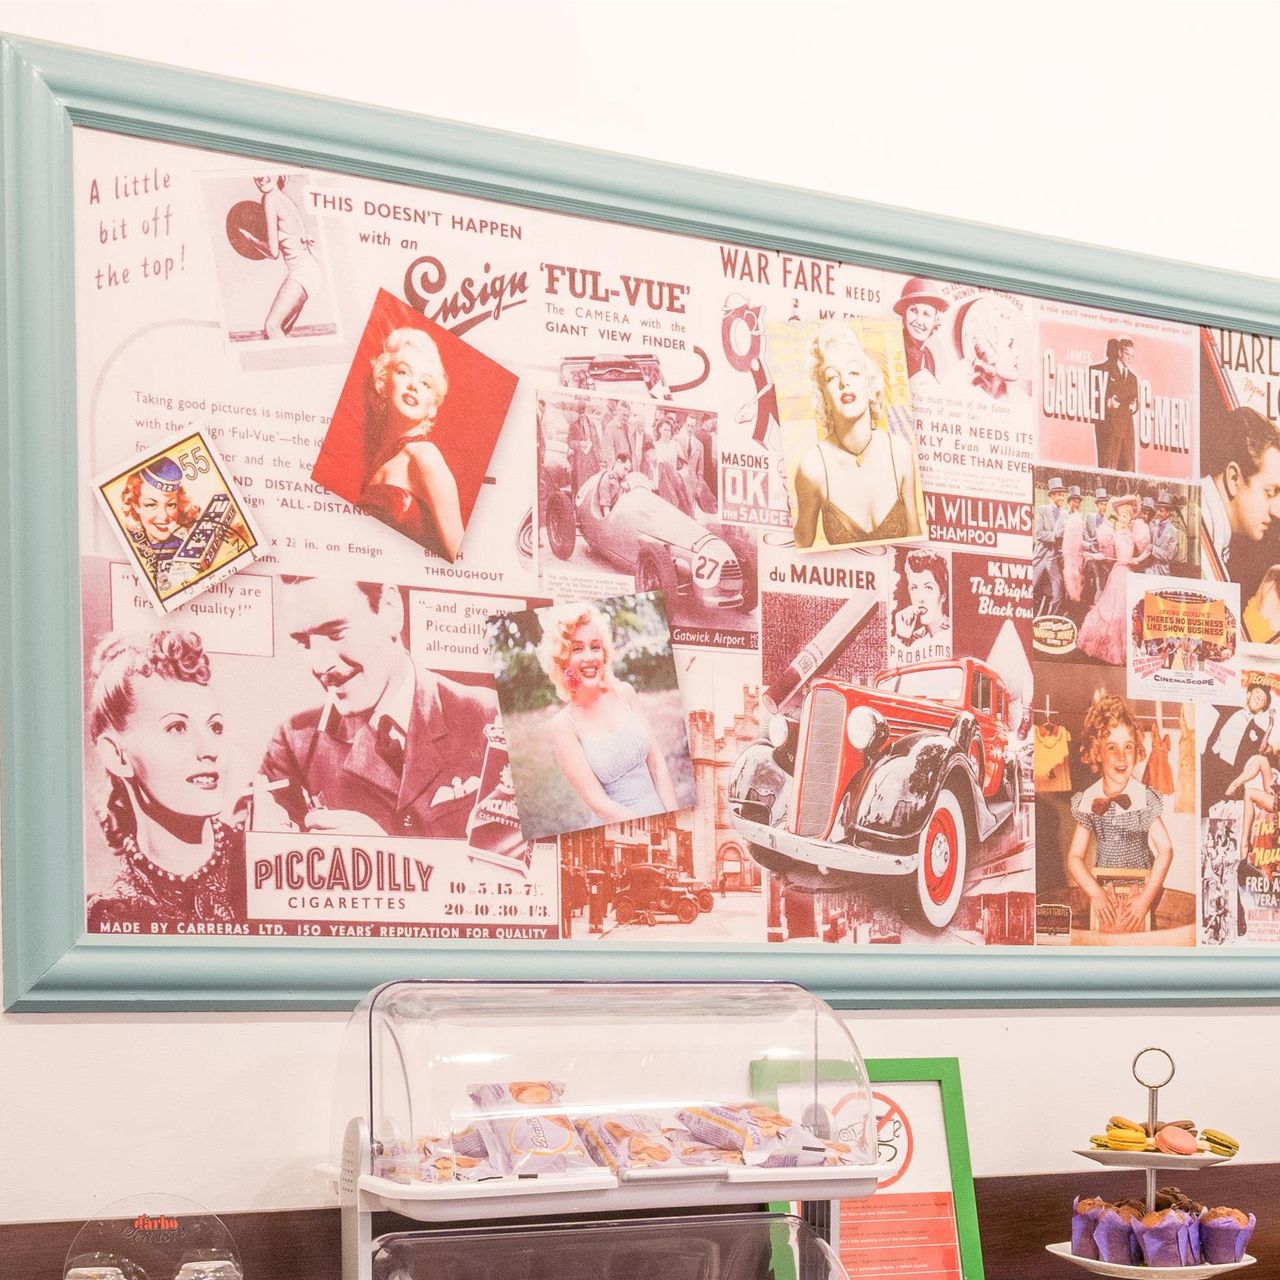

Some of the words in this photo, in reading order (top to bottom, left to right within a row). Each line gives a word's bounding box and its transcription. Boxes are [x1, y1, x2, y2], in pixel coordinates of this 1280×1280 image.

[90, 179, 100, 204] A
[115, 168, 170, 199] little
[100, 218, 127, 243] bit
[142, 204, 172, 238] off
[310, 192, 353, 212] THIS
[364, 201, 442, 226] DOESN'T
[452, 215, 522, 240] HAPPEN
[359, 231, 390, 246] with
[401, 239, 418, 250] an
[95, 264, 129, 290] the
[142, 244, 184, 280] top!
[720, 246, 770, 285] WAR
[846, 286, 881, 303] NEEDS
[403, 256, 528, 323] Ensign
[546, 302, 565, 315] The
[576, 307, 630, 324] CAMERA
[640, 319, 661, 330] with
[671, 322, 686, 333] the
[546, 322, 588, 337] GIANT
[599, 329, 632, 343] VIEW
[643, 335, 686, 350] FINDER
[1043, 348, 1109, 423] CAGNEY
[135, 391, 173, 410] Taking
[178, 399, 206, 411] good
[211, 402, 257, 417] pictures
[263, 407, 271, 417] is
[276, 409, 317, 425] simpler
[135, 419, 161, 430] with
[166, 422, 184, 431] the
[931, 421, 962, 435] HAIR
[970, 426, 1009, 442] NEEDS
[954, 439, 978, 452] Evan
[178, 446, 210, 481] 55
[245, 455, 264, 465] and
[273, 457, 291, 469] the
[721, 452, 769, 470] MASON'S
[933, 453, 966, 466] MORE
[970, 456, 1003, 471] THAN
[738, 507, 788, 525] SAUCE
[941, 496, 1032, 532] WILLIAMS
[930, 525, 995, 545] SHAMPOO
[326, 543, 340, 552] on
[348, 542, 383, 556] Ensign
[424, 566, 505, 582] THROUGHOUT
[695, 555, 719, 580] 27
[770, 566, 786, 583] du
[791, 563, 876, 591] MAURIER
[240, 587, 261, 597] are
[970, 576, 991, 595] The
[465, 604, 488, 618] give
[978, 597, 1013, 618] Black
[426, 620, 488, 637] Piccadilly
[1147, 623, 1162, 631] LIKE
[1163, 624, 1184, 633] SHOW
[1187, 627, 1223, 636] BUSINESS
[1176, 617, 1185, 625] NO
[1187, 619, 1223, 628] BUSINESS
[673, 629, 710, 643] Gatwick
[714, 635, 745, 646] Airport
[426, 641, 484, 655] all-round
[890, 644, 951, 663] PROBLEMS
[1253, 819, 1275, 836] The
[254, 847, 434, 892] PICCADILLY
[1246, 876, 1270, 892] FRED
[288, 897, 406, 910] CIGARETTES
[100, 921, 141, 934] MADE
[150, 922, 169, 934] BY
[177, 922, 250, 935] CARRERAS
[258, 924, 287, 936] LTD.
[298, 924, 321, 937] 150
[330, 924, 375, 937] YEARS'
[380, 926, 461, 939] REPUTATION
[466, 927, 489, 939] FOR
[496, 927, 547, 940] QUALITY
